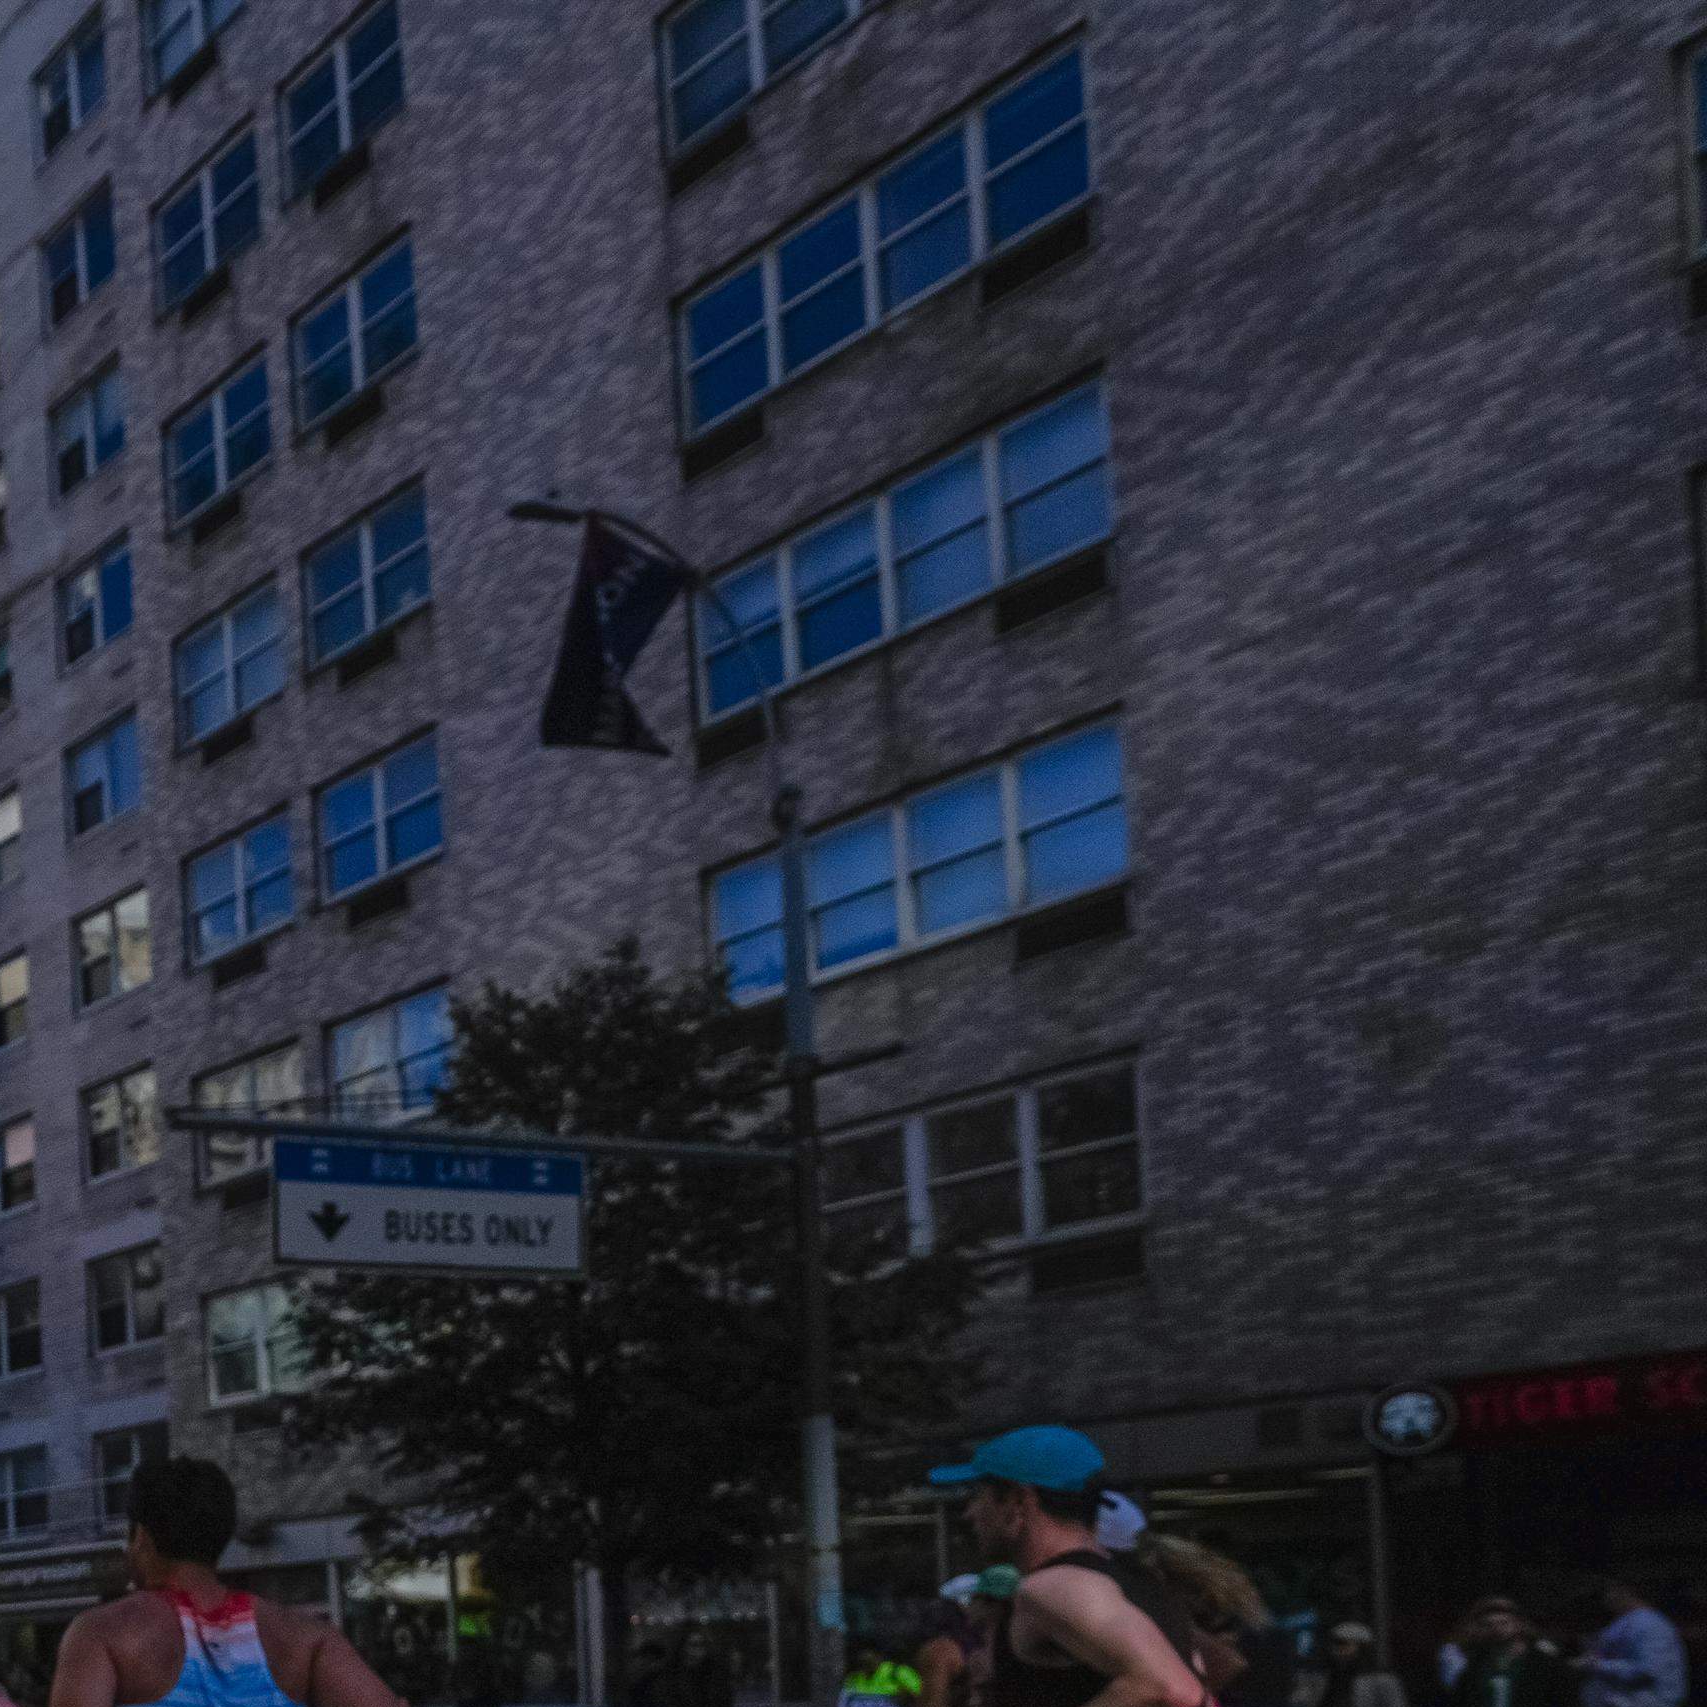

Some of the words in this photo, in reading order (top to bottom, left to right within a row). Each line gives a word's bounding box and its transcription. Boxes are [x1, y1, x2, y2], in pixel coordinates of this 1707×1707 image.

[371, 1153, 413, 1181] BUS
[436, 1155, 492, 1184] LANE
[384, 1208, 474, 1244] BUSES
[484, 1212, 554, 1248] ONLY
